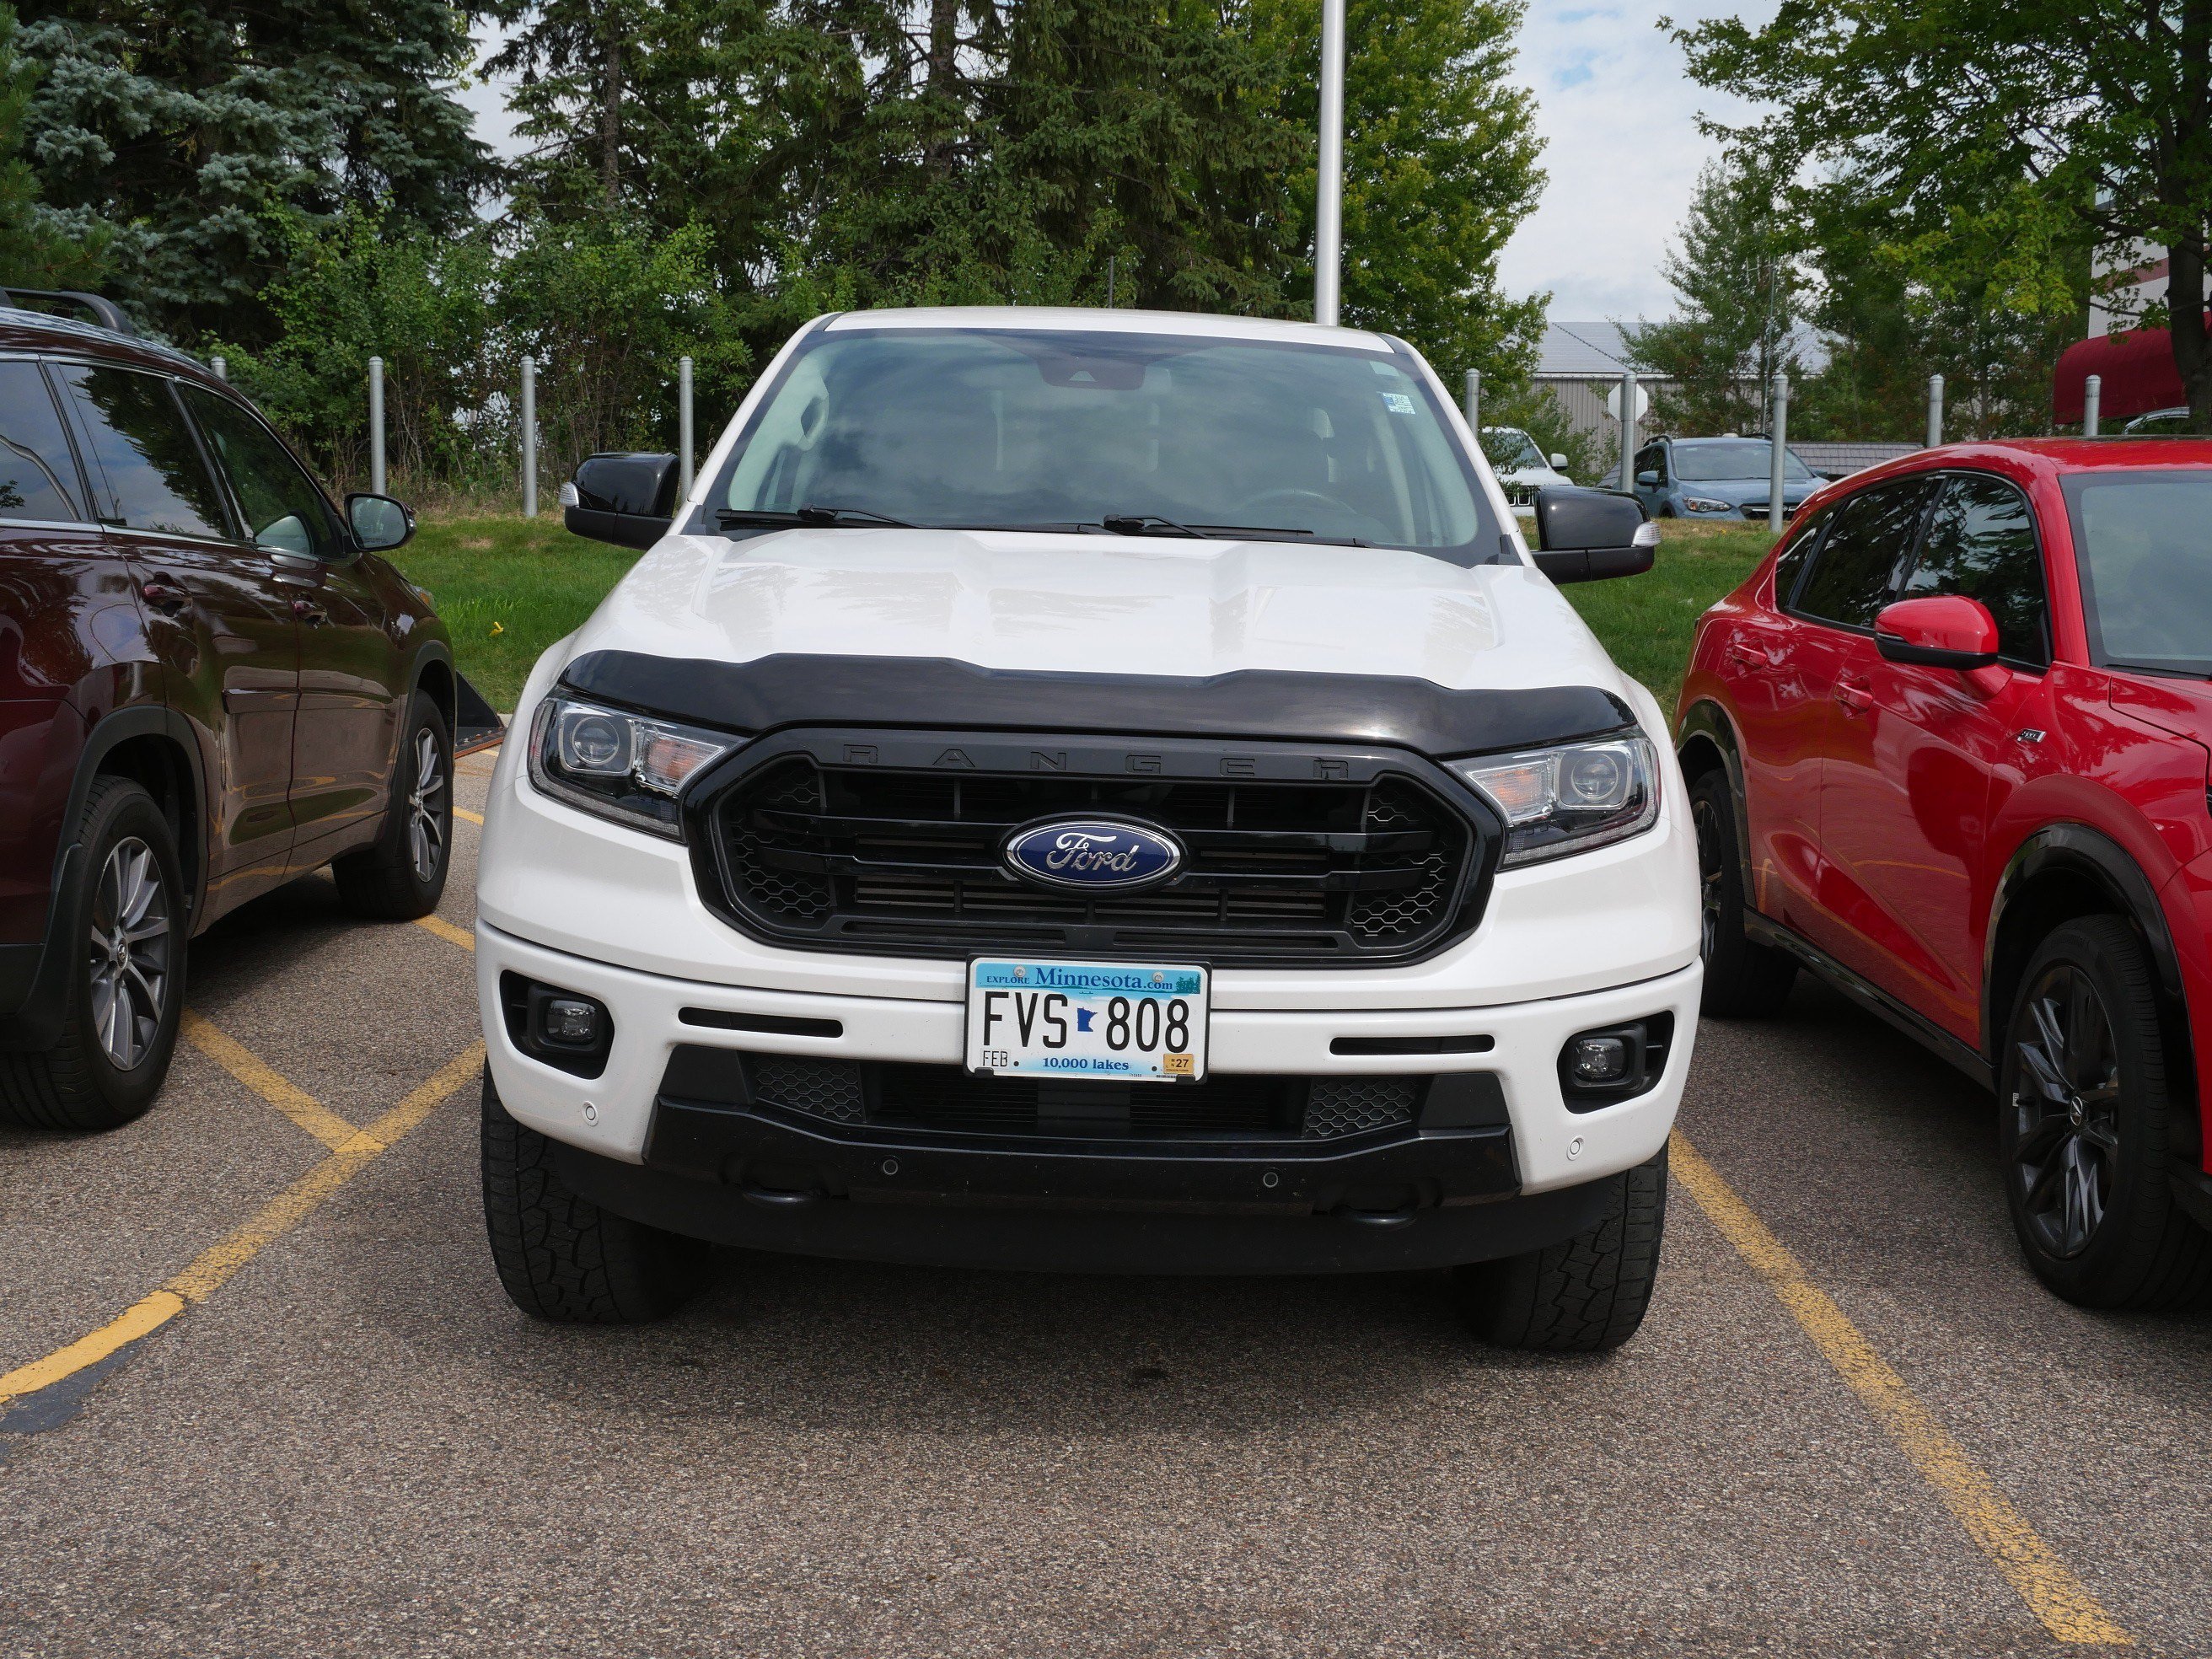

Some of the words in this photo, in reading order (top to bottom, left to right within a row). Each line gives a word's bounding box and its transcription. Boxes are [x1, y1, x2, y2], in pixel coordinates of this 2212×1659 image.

[843, 744, 1349, 779] RANGER
[1046, 832, 1140, 872] Ford
[986, 975, 1030, 984] EXPLORE
[983, 991, 1068, 1049] FVS
[1106, 996, 1189, 1053] 808
[983, 1050, 1007, 1066] FEB
[1043, 1057, 1087, 1069] 10,000
[1093, 1059, 1129, 1070] lakes
[1176, 1059, 1189, 1067] 27
